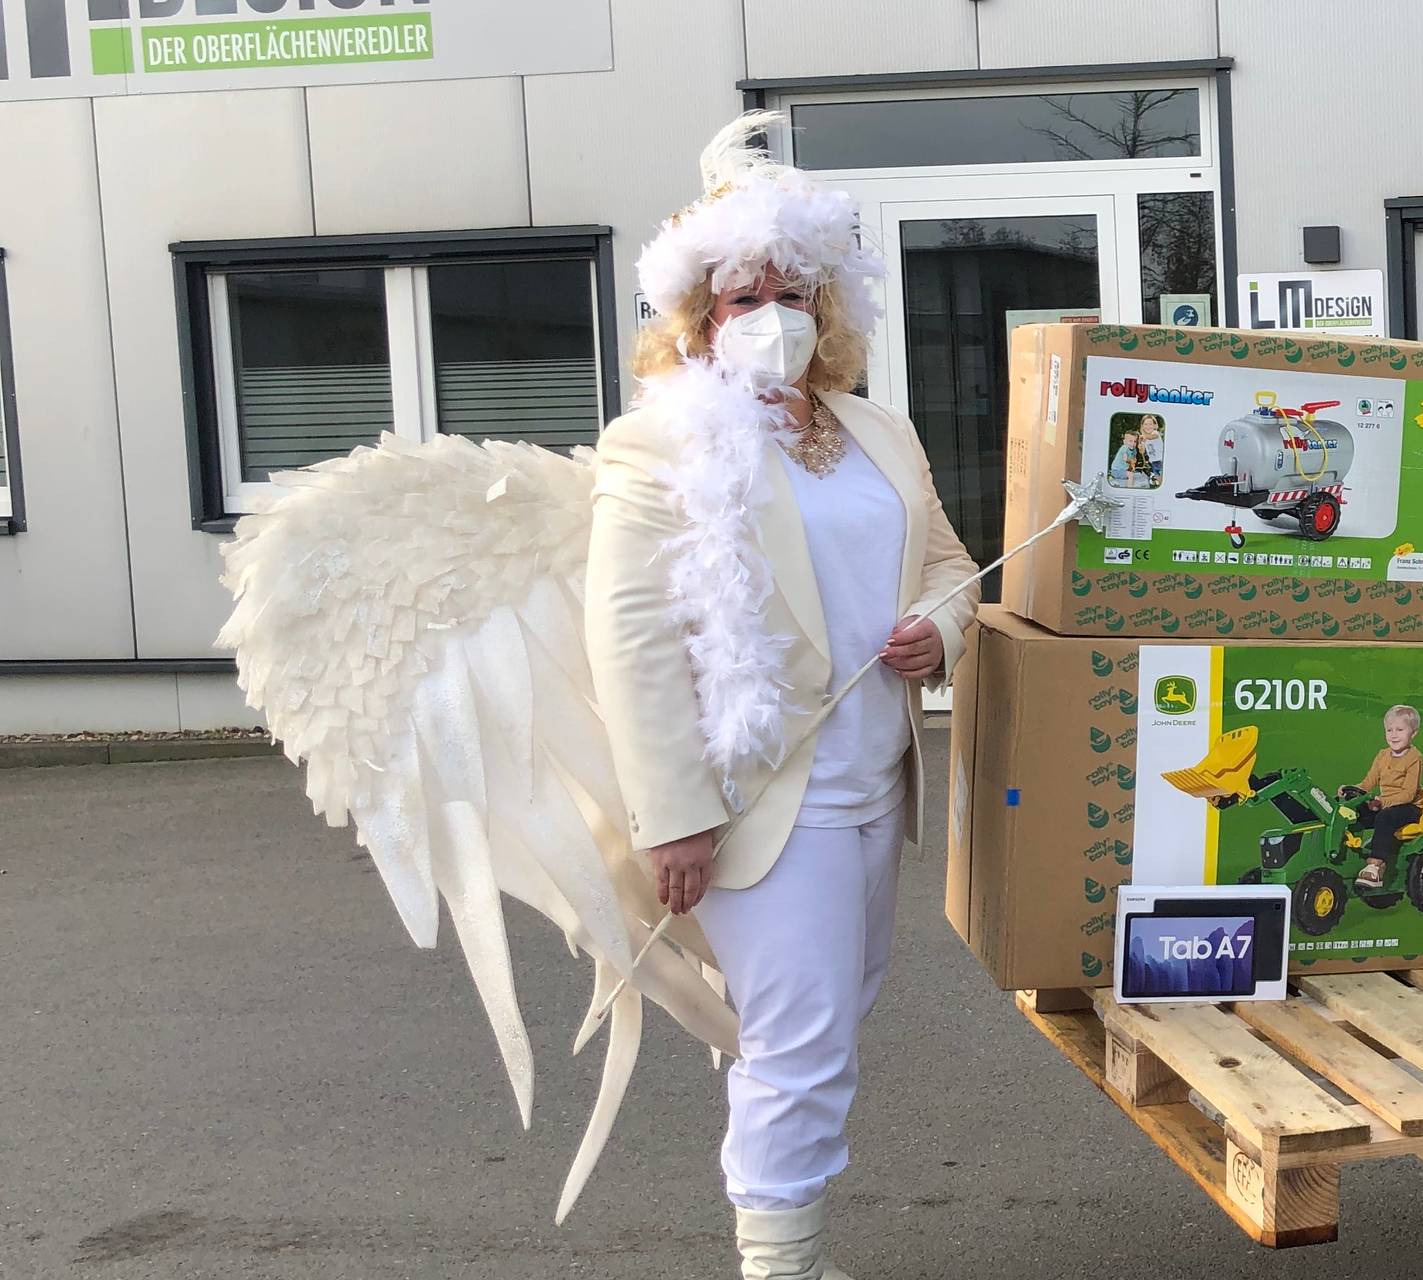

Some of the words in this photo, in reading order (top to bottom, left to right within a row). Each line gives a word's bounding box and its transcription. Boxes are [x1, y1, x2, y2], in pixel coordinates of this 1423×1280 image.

[149, 36, 186, 66] DER
[193, 24, 429, 64] OBERFLÄCHENVEREDLER
[1100, 378, 1214, 405] rollytanker
[1234, 679, 1328, 711] 6210R
[1159, 935, 1213, 960] Tab
[1215, 935, 1252, 960] A7
